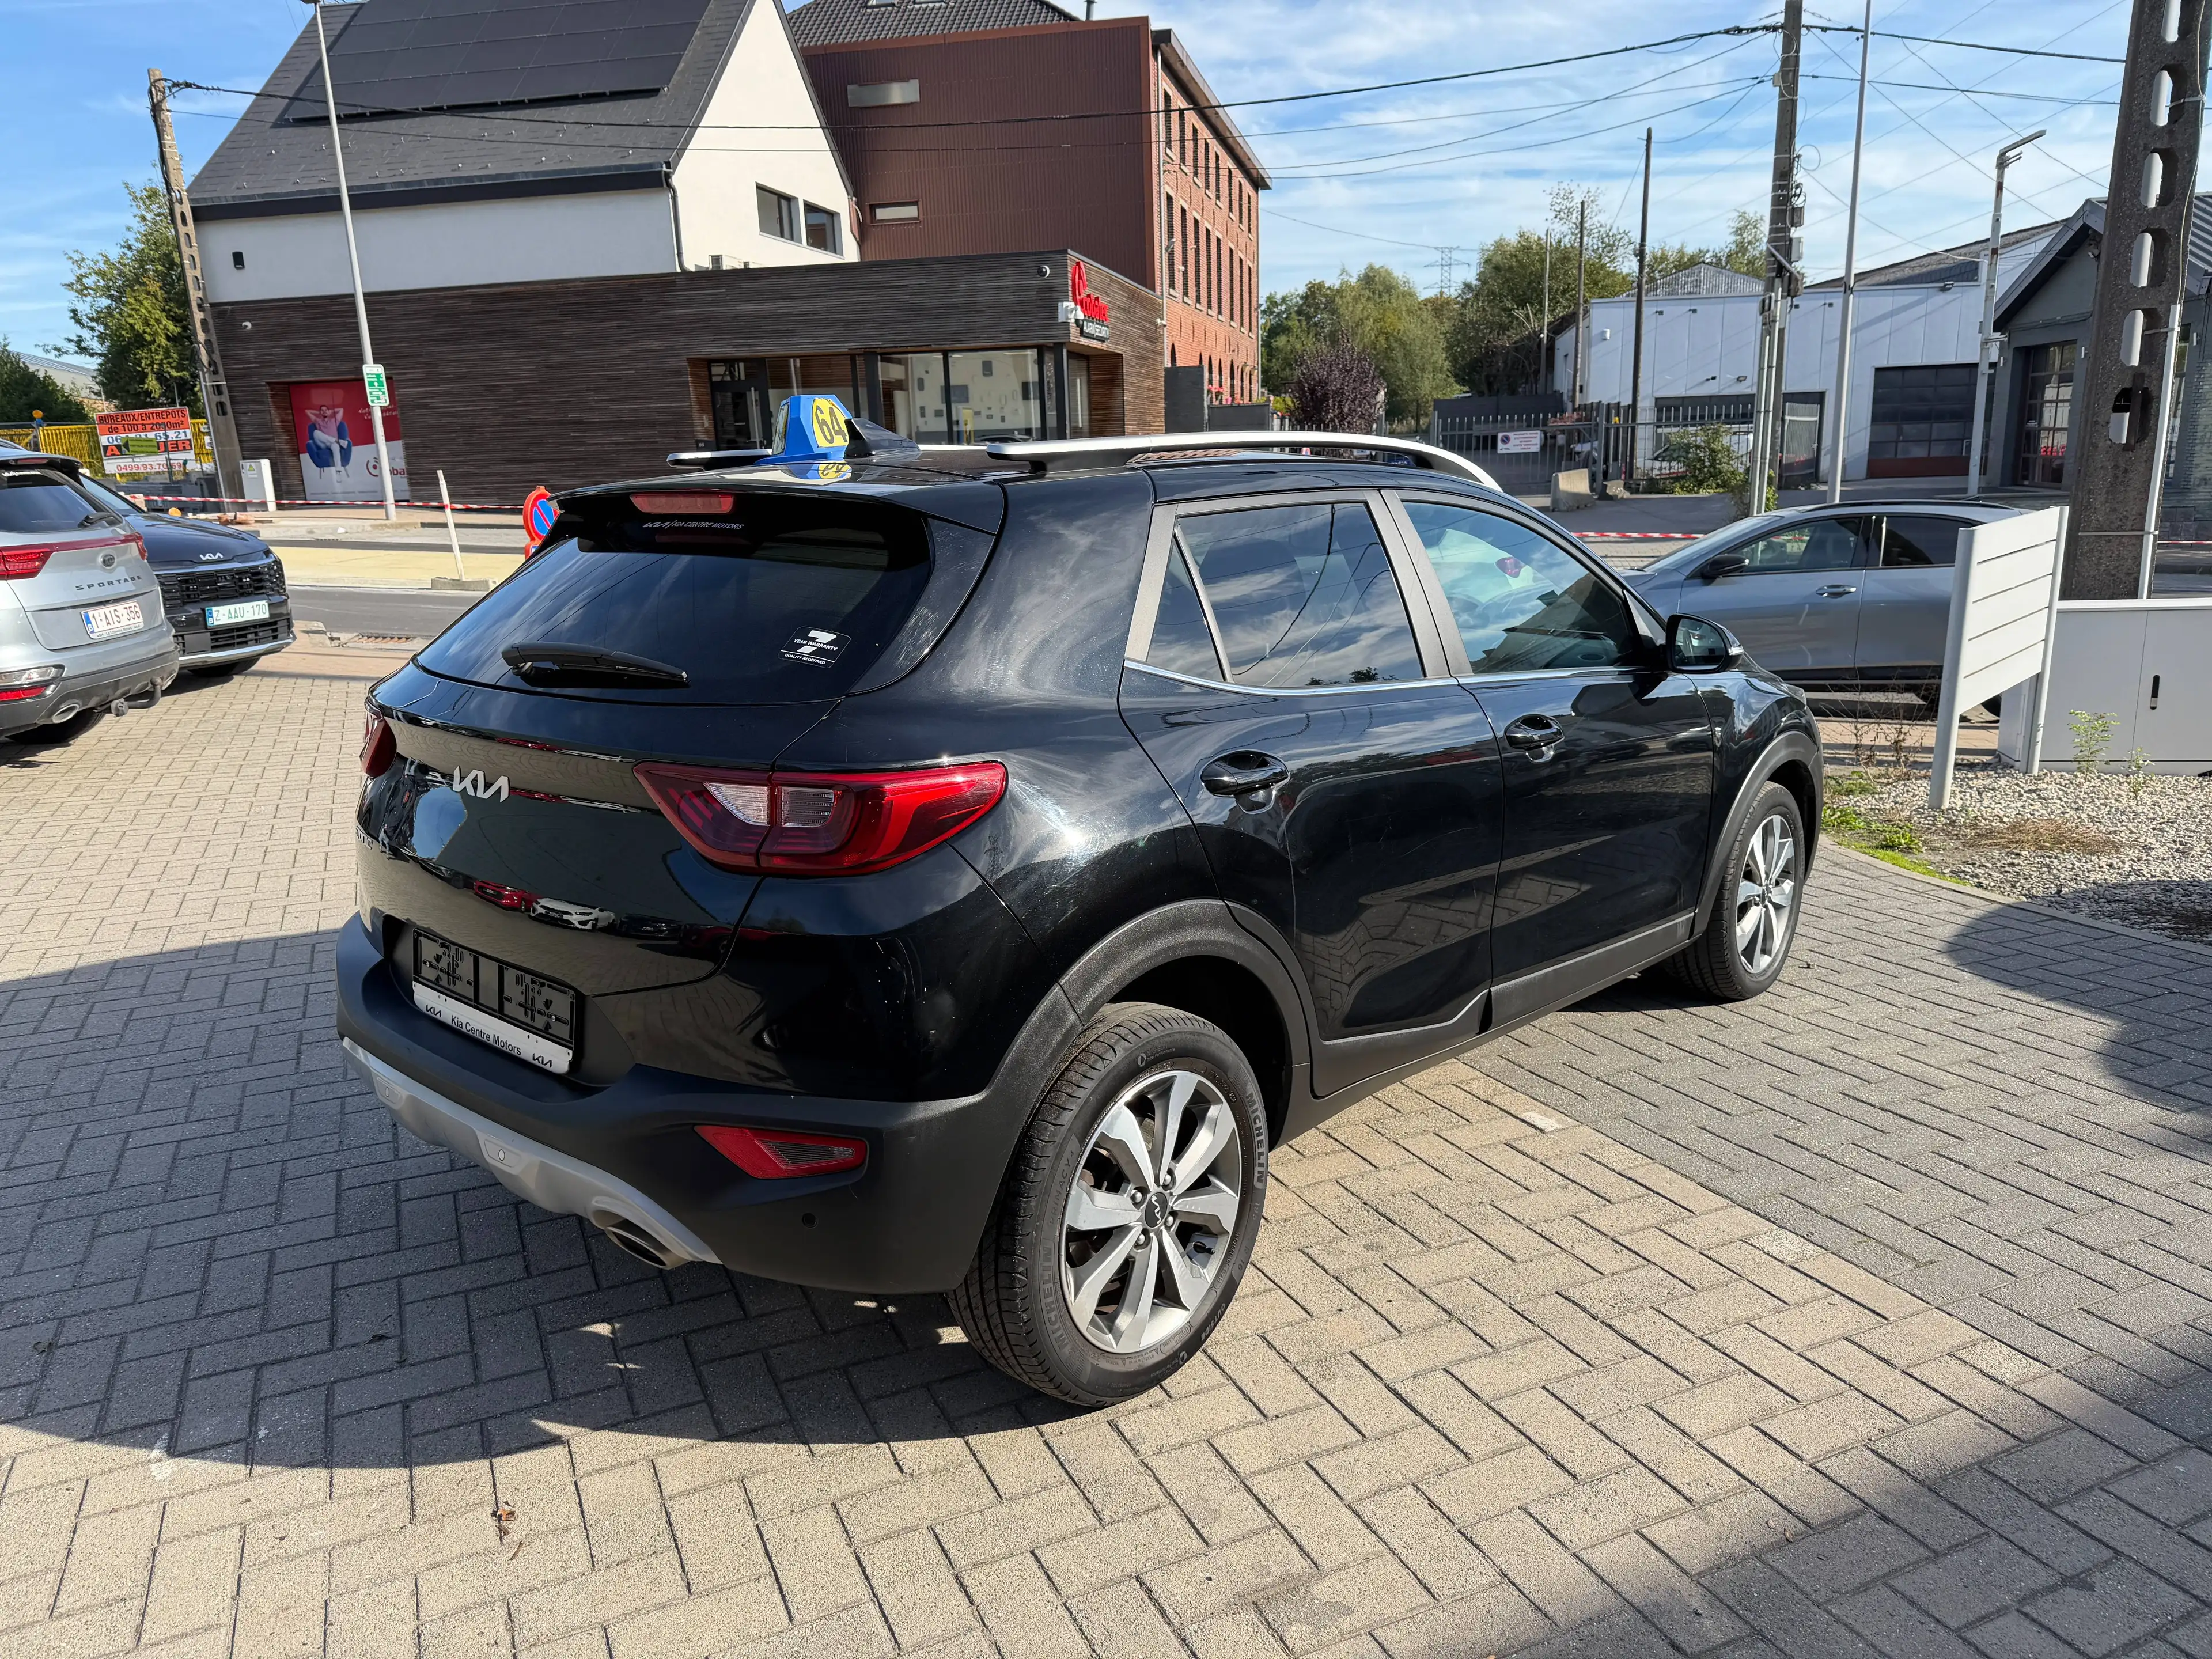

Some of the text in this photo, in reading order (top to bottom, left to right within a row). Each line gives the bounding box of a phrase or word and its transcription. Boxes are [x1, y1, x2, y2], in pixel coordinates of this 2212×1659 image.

[108, 425, 119, 433] de
[122, 423, 139, 432] 100
[815, 405, 848, 444] 64
[106, 445, 120, 456] A
[75, 575, 142, 590] SPORTAGE
[797, 630, 837, 654] 7
[808, 641, 838, 651] WARRANTY
[802, 657, 826, 665] REDEFINED
[453, 766, 510, 802] KIA
[426, 1004, 552, 1068] KIA Kia Centre Motors KIA
[1246, 1092, 1265, 1183] MICHELIN
[1050, 1158, 1071, 1225] PRIMACY
[1042, 1247, 1069, 1351] MICHELIN
[1201, 1303, 1226, 1342] OUTSIDE
